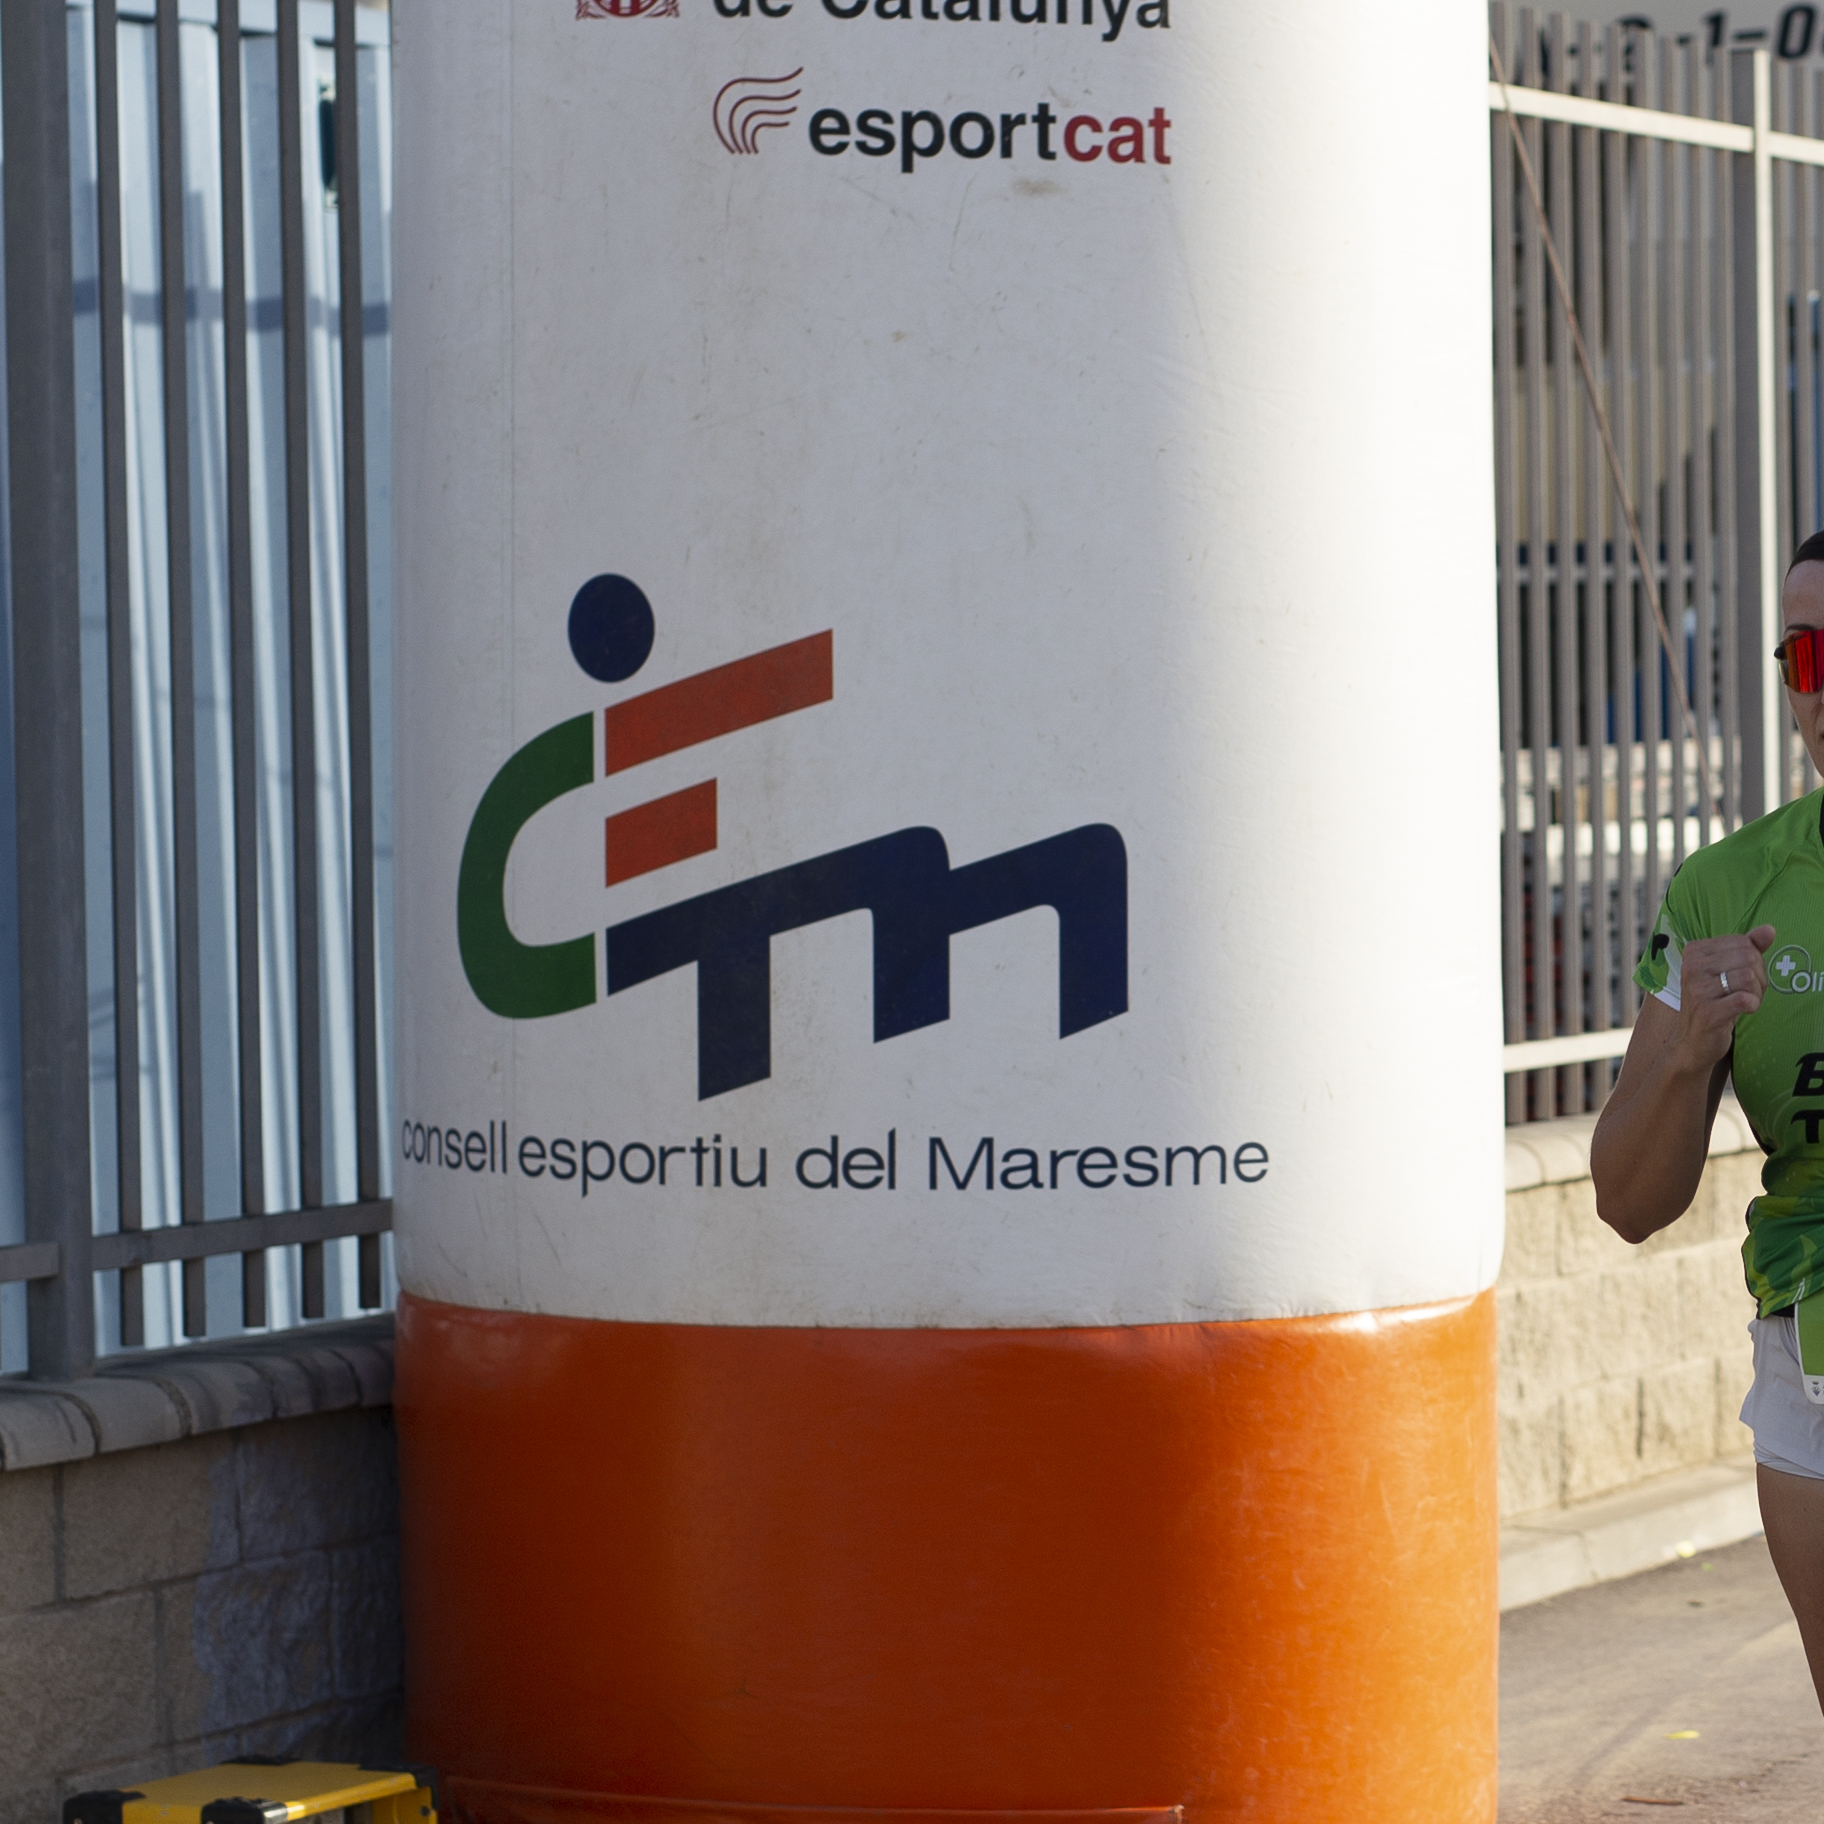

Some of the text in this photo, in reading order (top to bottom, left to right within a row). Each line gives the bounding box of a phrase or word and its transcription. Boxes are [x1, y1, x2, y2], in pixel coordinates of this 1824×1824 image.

[808, 102, 1172, 174] esportcat
[402, 1119, 1271, 1198] consell esportiu del Maresme
